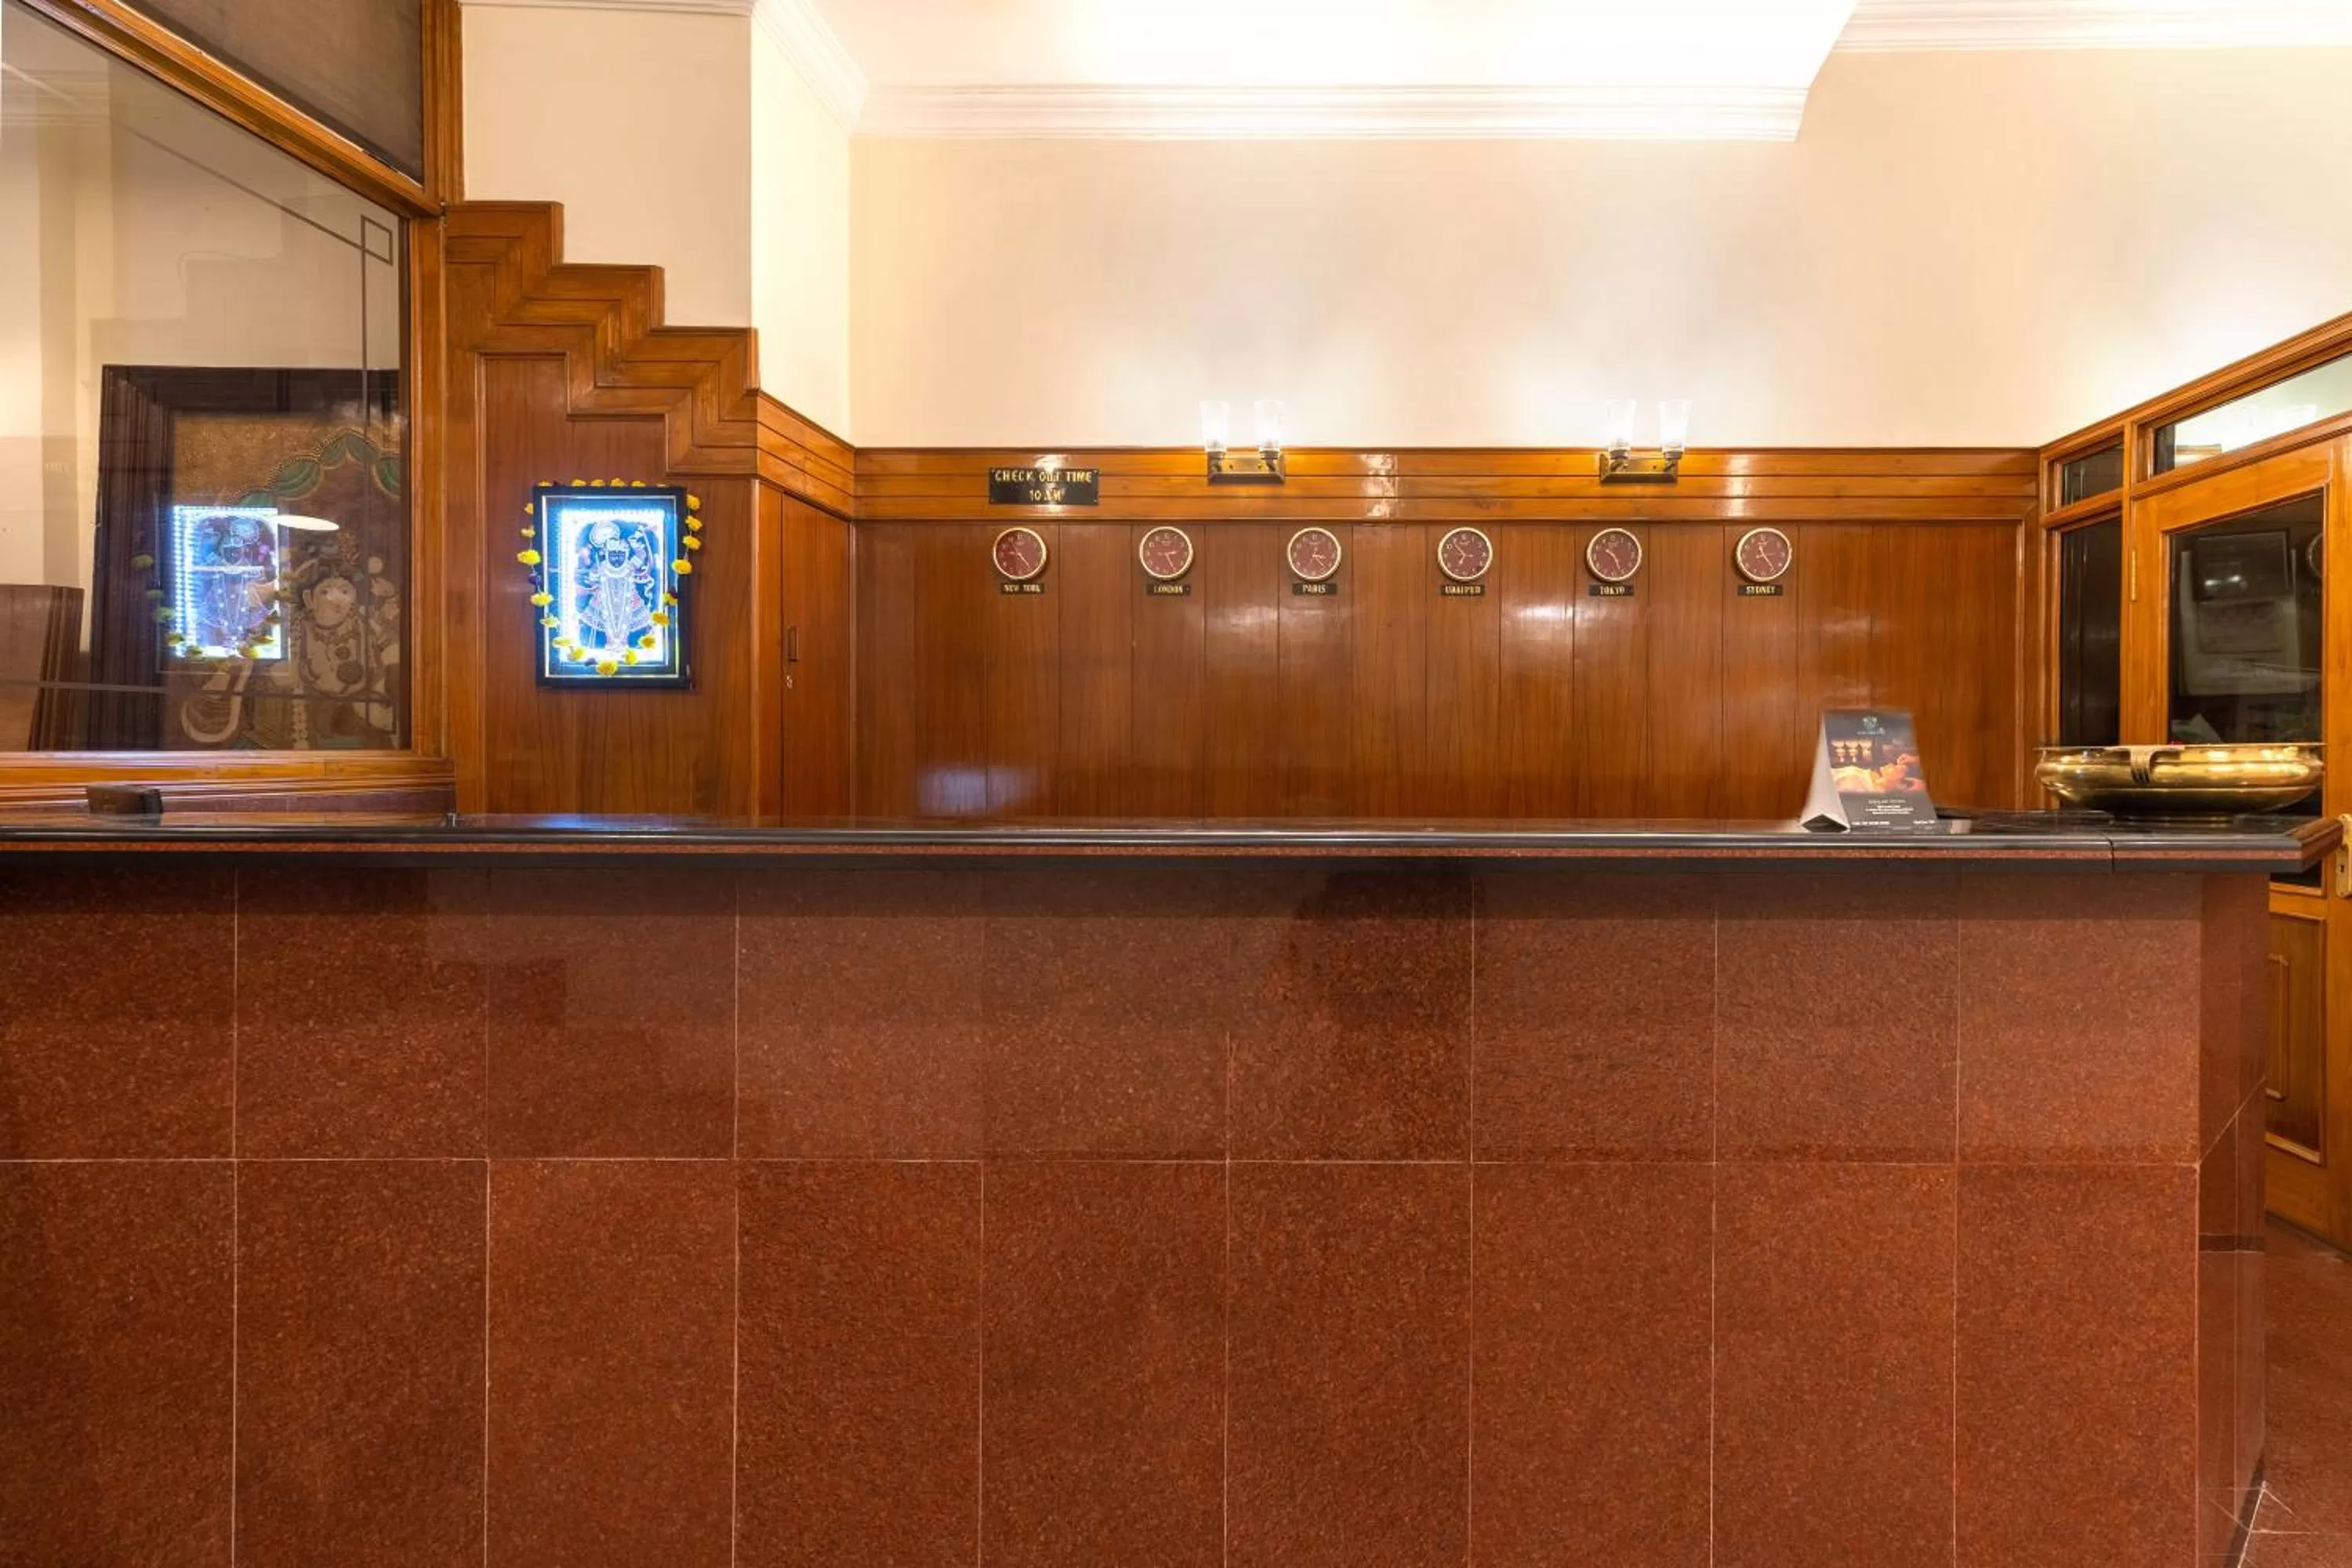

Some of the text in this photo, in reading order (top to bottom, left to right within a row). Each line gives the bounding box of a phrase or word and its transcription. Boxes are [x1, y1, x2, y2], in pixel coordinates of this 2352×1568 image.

[994, 470, 1092, 483] CHECK OUT TIME
[1029, 489, 1042, 501] 10
[1004, 584, 1041, 593] NEW YORK
[1154, 584, 1183, 593] LONDON
[1302, 585, 1327, 593] PARIS
[1599, 586, 1625, 596] TOKYO
[1746, 586, 1775, 596] SYDNEY
